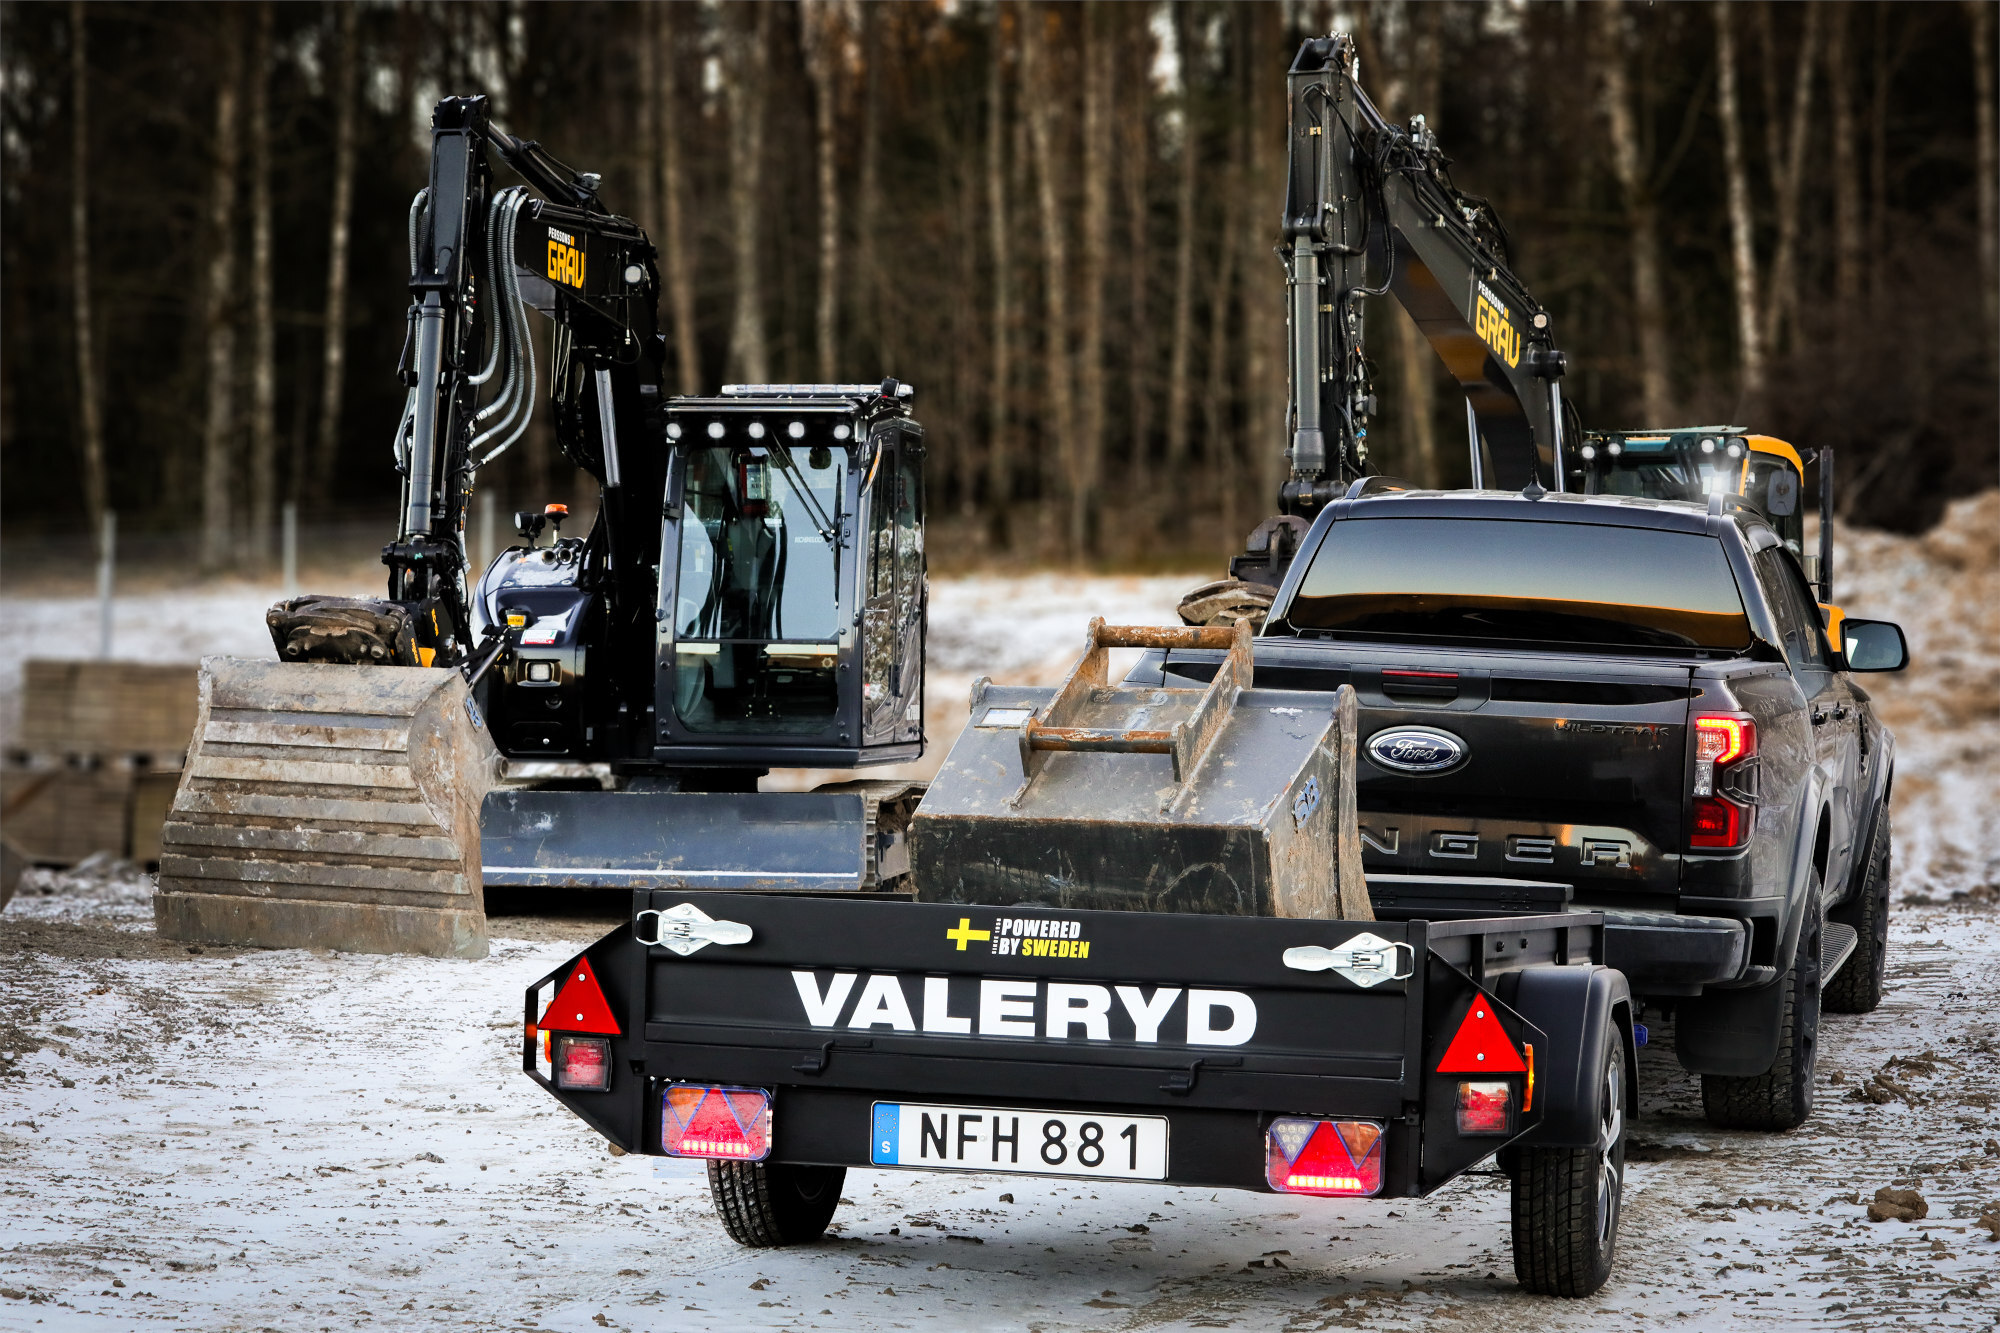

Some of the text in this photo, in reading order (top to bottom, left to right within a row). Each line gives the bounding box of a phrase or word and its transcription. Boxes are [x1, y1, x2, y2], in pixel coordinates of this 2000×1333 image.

[548, 226, 570, 245] PERSSONS
[1478, 280, 1505, 315] PERSSONS
[1553, 722, 1670, 736] WILDTRAK
[1390, 739, 1439, 760] Ford
[1359, 826, 1633, 868] NGER
[1001, 918, 1081, 938] POWERED
[998, 937, 1090, 958] BY SWEDEN
[791, 971, 1258, 1047] VALERYD
[881, 1140, 891, 1153] S
[920, 1112, 1138, 1170] NFH 881
